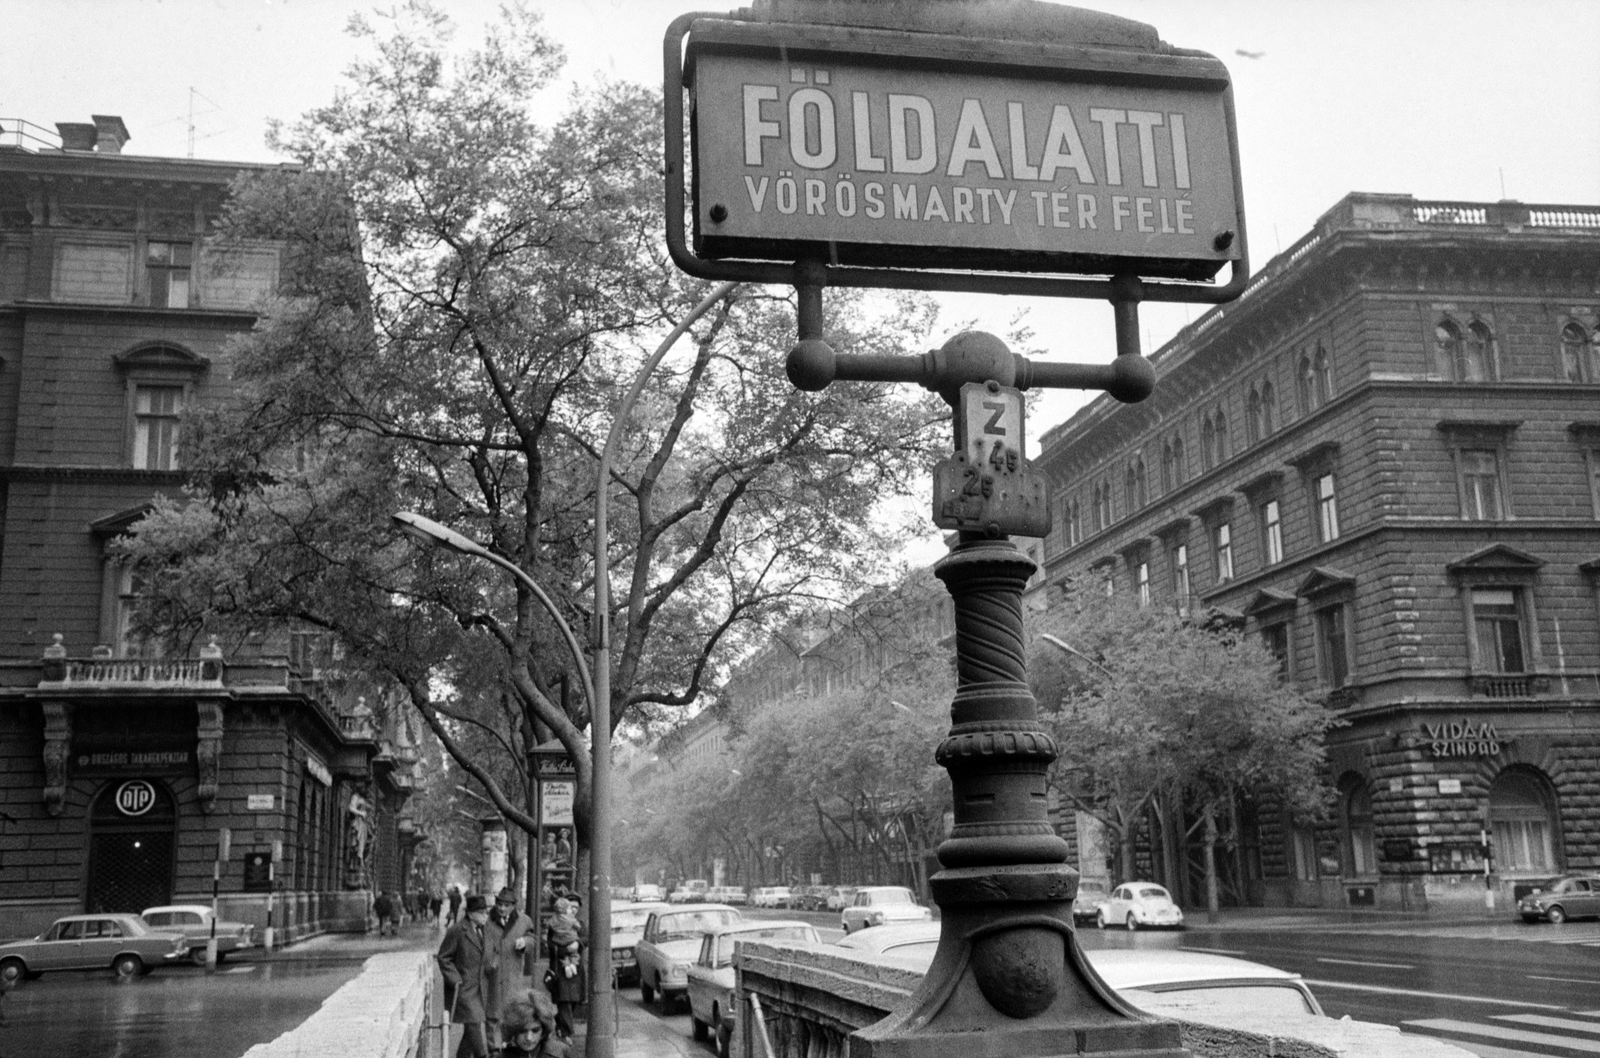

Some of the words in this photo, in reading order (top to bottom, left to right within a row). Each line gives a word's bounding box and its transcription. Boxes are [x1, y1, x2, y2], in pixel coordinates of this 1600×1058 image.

[741, 68, 1192, 190] FÖLDALATTI
[743, 170, 1018, 226] VÖRÖSMARTY
[1031, 186, 1098, 230] TÉR
[1112, 192, 1196, 236] FELÉ
[982, 401, 1006, 436] Z
[1425, 717, 1498, 740] VIDÁM
[123, 785, 149, 811] OTP
